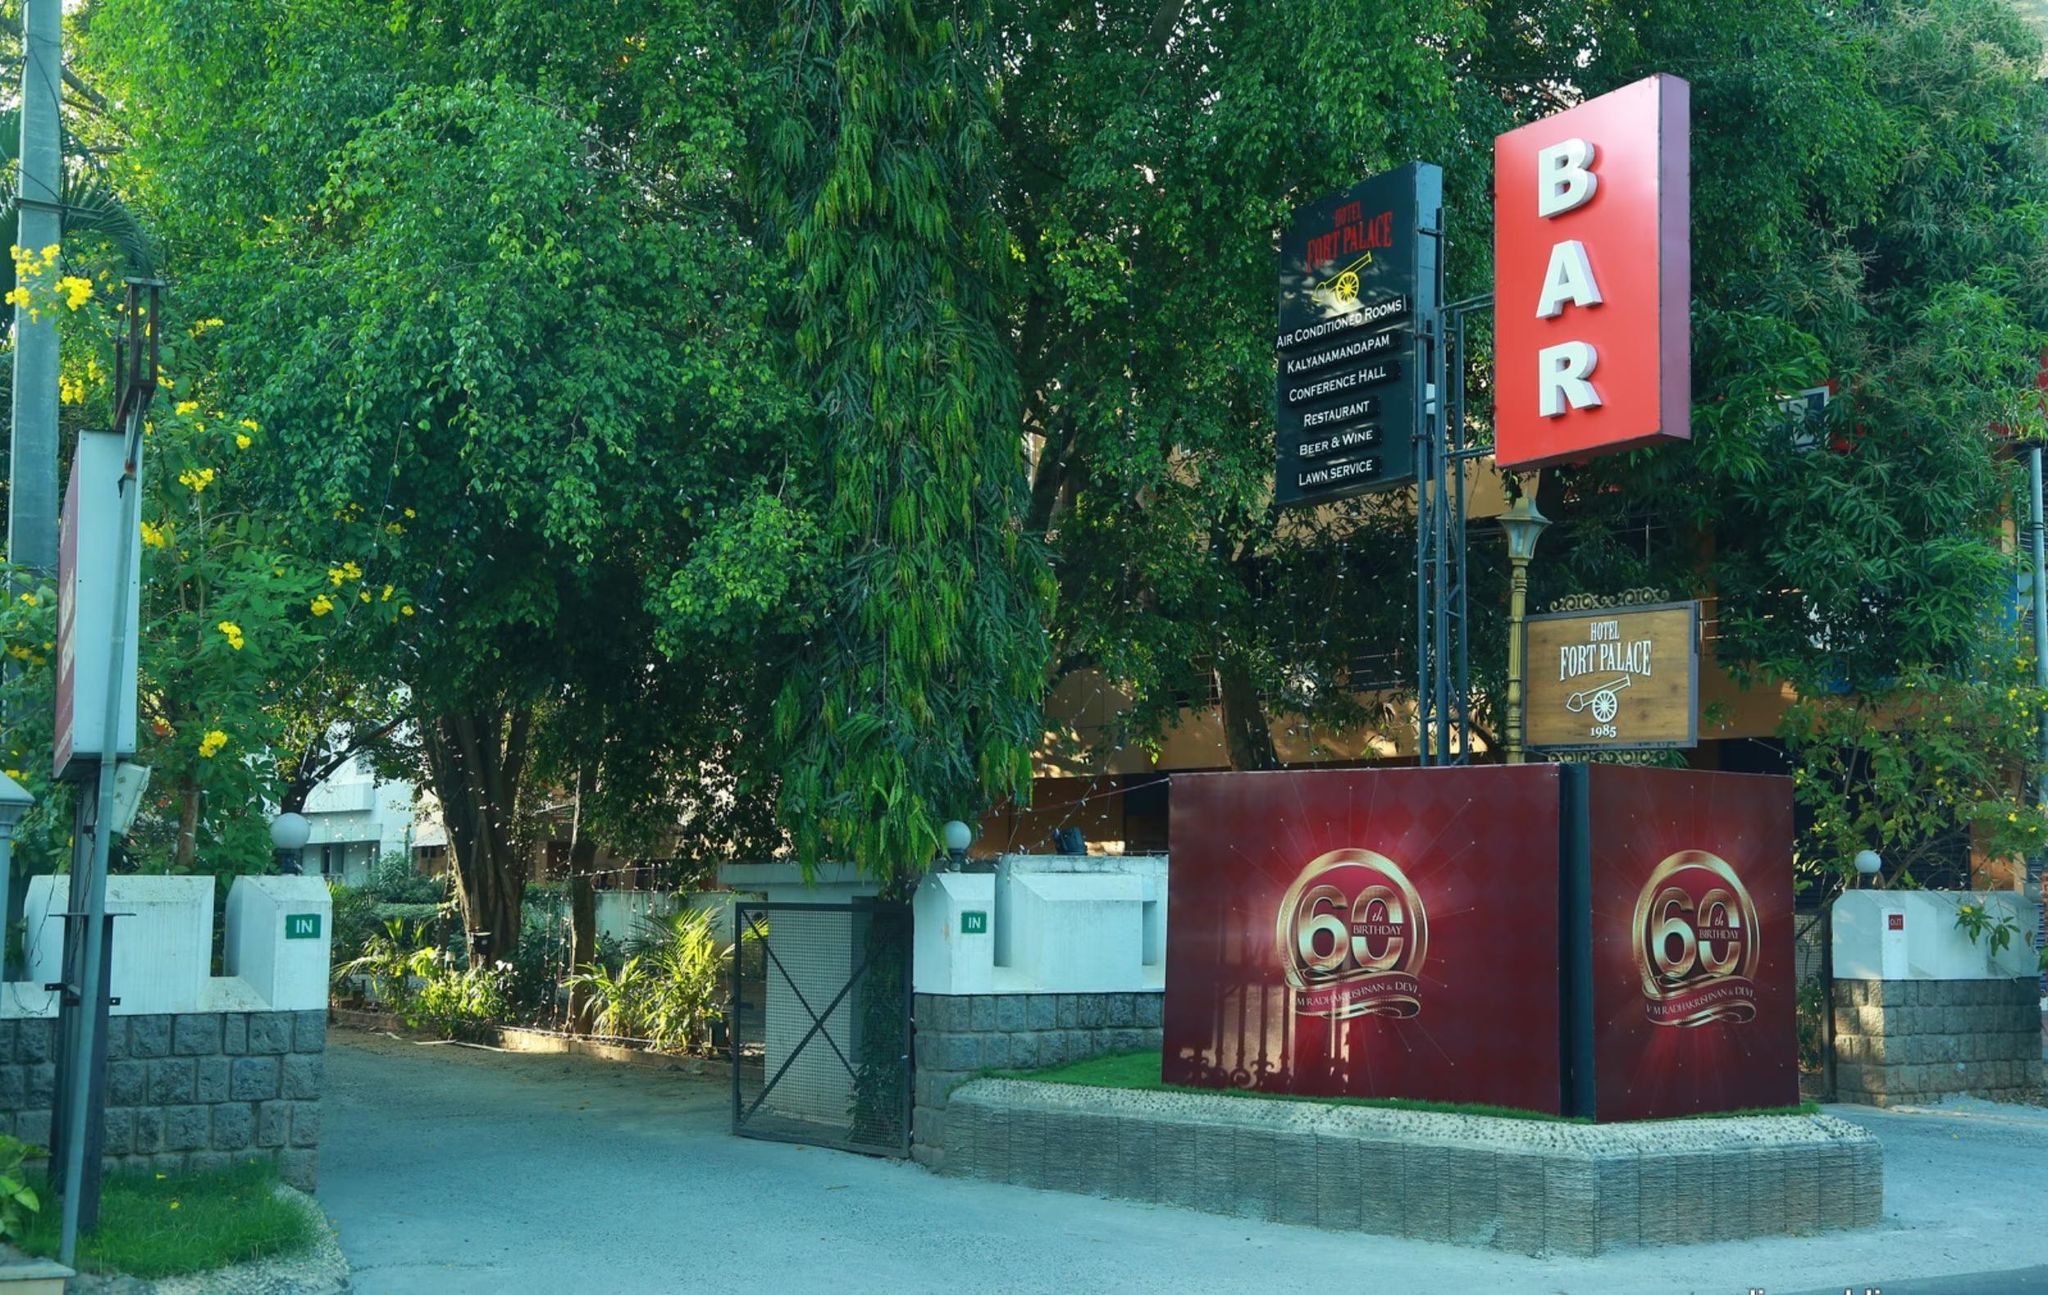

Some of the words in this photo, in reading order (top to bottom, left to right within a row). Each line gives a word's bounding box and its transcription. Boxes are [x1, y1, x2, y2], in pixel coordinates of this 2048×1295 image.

[1334, 200, 1362, 230] HOTEL
[1306, 230, 1340, 273] FORT
[1343, 211, 1393, 254] PALACE
[1536, 138, 1602, 420] BAR
[1276, 334, 1293, 348] AIR
[1294, 311, 1362, 342] CONDITIONED
[1364, 299, 1402, 321] ROOMS
[1287, 334, 1390, 374] KALYANAMANDAPAM
[1289, 374, 1356, 402] CONFERENCE
[1358, 366, 1387, 383] HALL
[1304, 400, 1370, 427] RESTAURANT
[1299, 441, 1329, 456] BEER
[1331, 437, 1340, 448] &
[1342, 429, 1373, 446] WINE
[1299, 469, 1328, 486] LAWN
[1330, 459, 1373, 479] SERVICE
[1590, 620, 1620, 642] HOTEL
[1559, 644, 1596, 682] FORT
[1600, 640, 1652, 677] PALACE
[1590, 725, 1617, 738] 1985
[296, 919, 313, 933] IN
[968, 916, 981, 929] IN
[1298, 884, 1405, 972] 60
[1352, 924, 1402, 935] BIRTHDAY
[1652, 886, 1741, 978] 60
[1698, 928, 1739, 940] BIRTHDAY
[1395, 981, 1418, 994] DEVI
